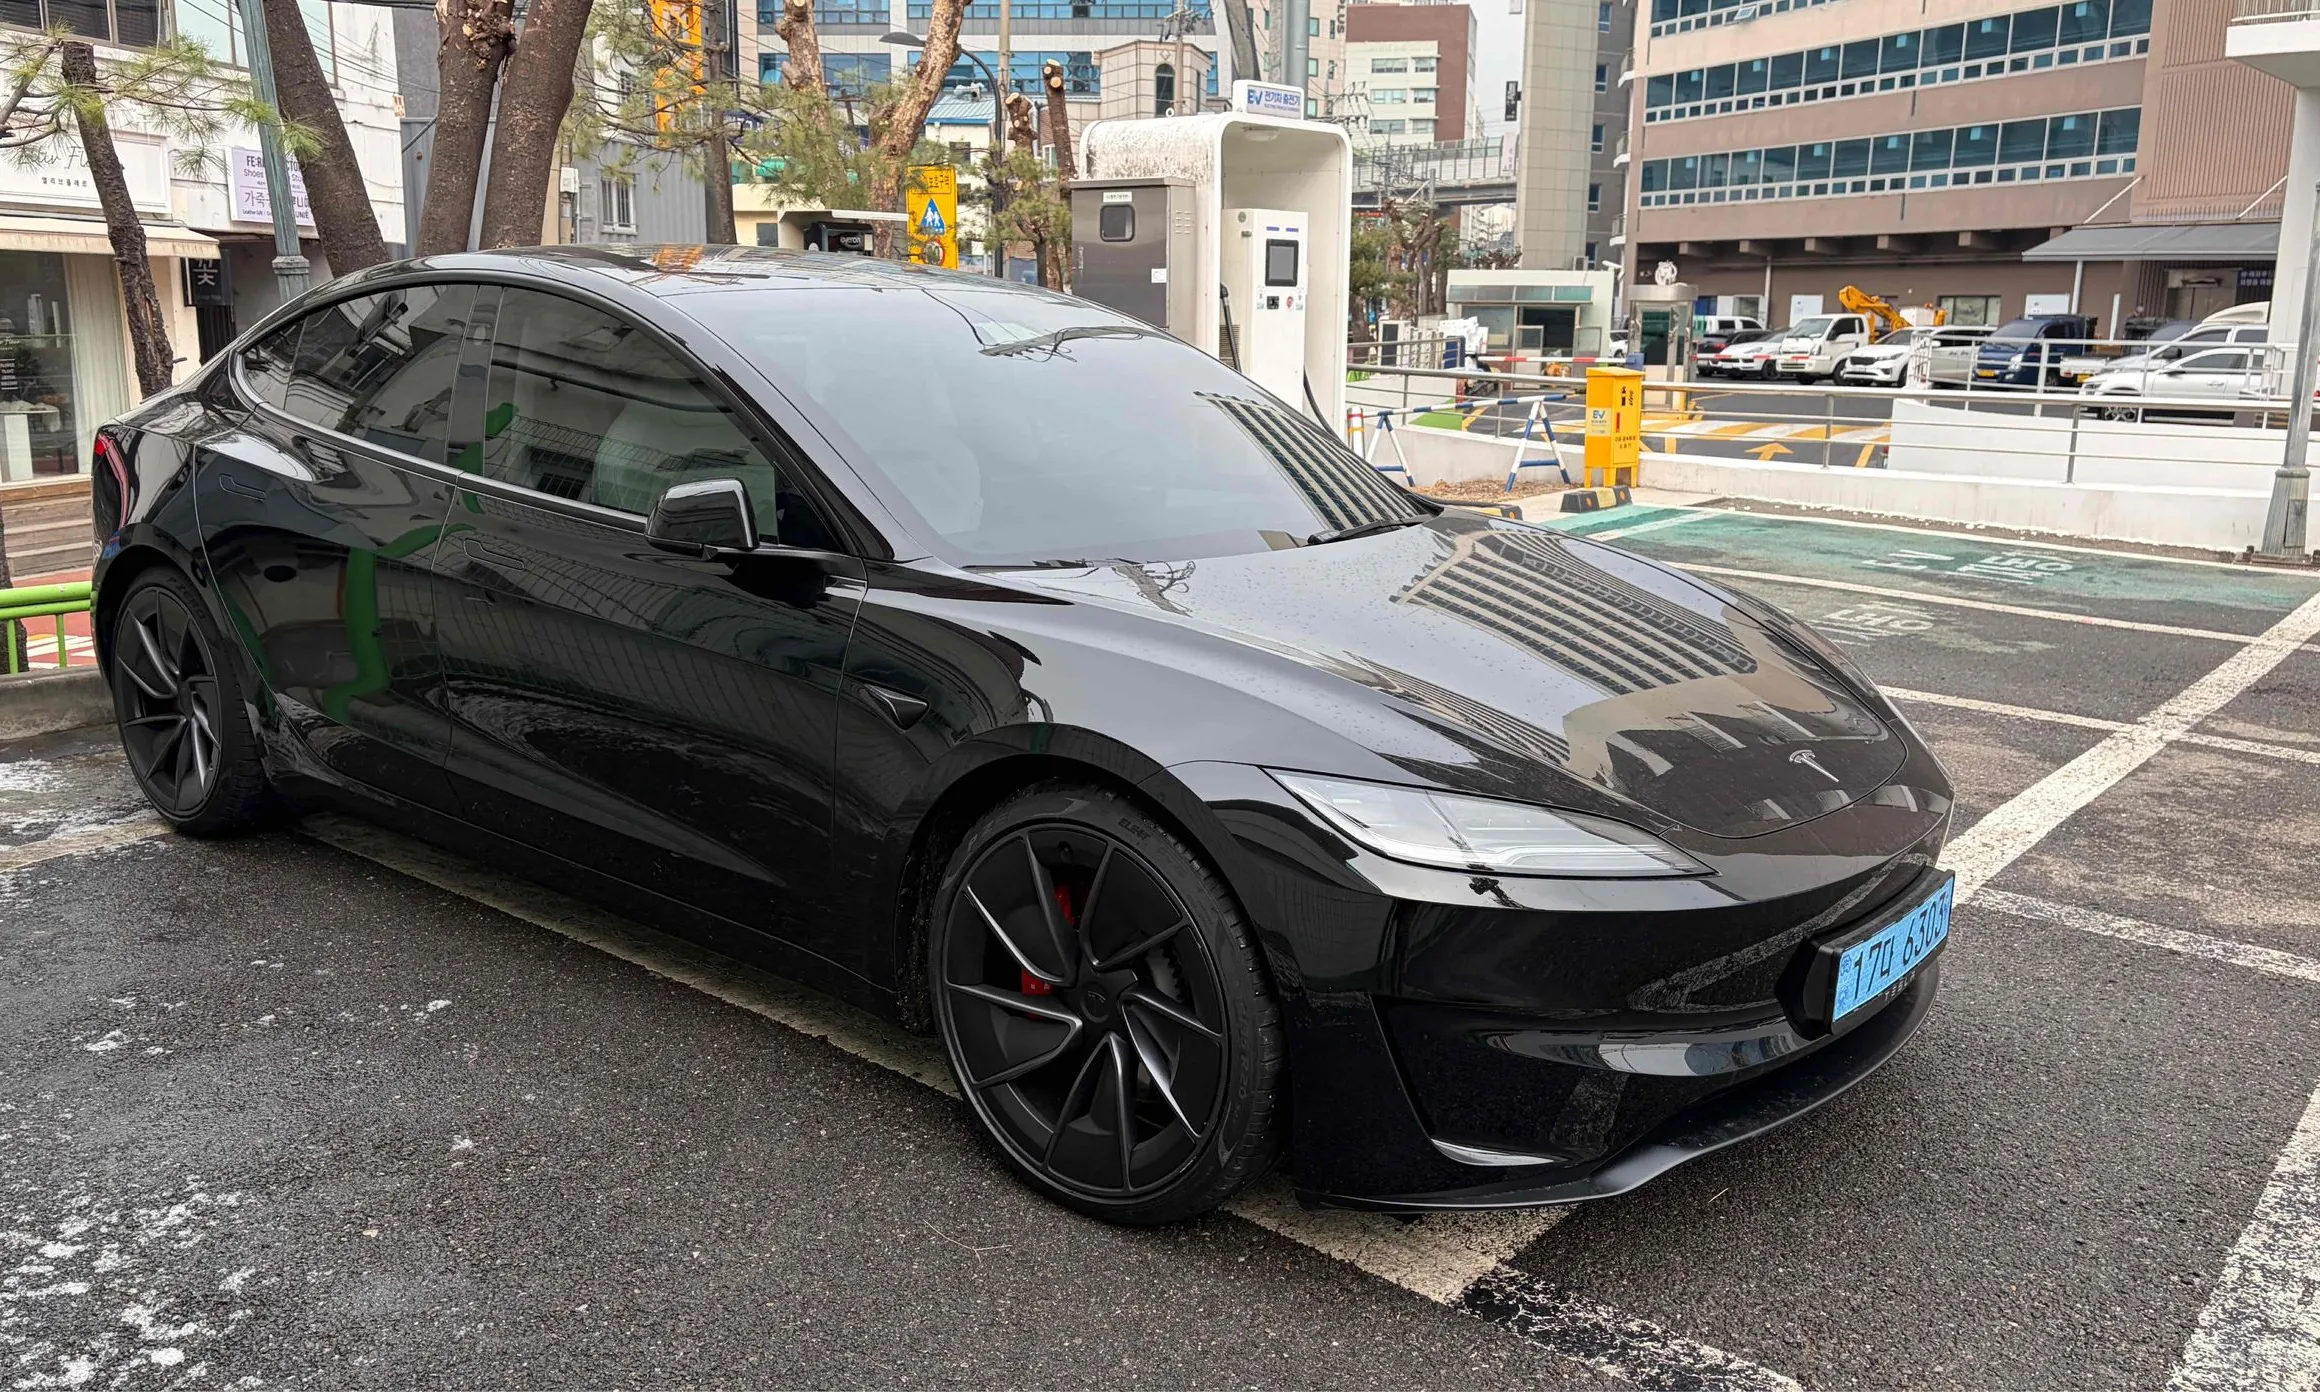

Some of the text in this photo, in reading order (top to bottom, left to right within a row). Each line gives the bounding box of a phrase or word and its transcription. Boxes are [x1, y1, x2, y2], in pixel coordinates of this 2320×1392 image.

[1247, 89, 1263, 105] EV
[1592, 409, 1606, 420] EV
[1853, 891, 1947, 1000] 17다 6303
